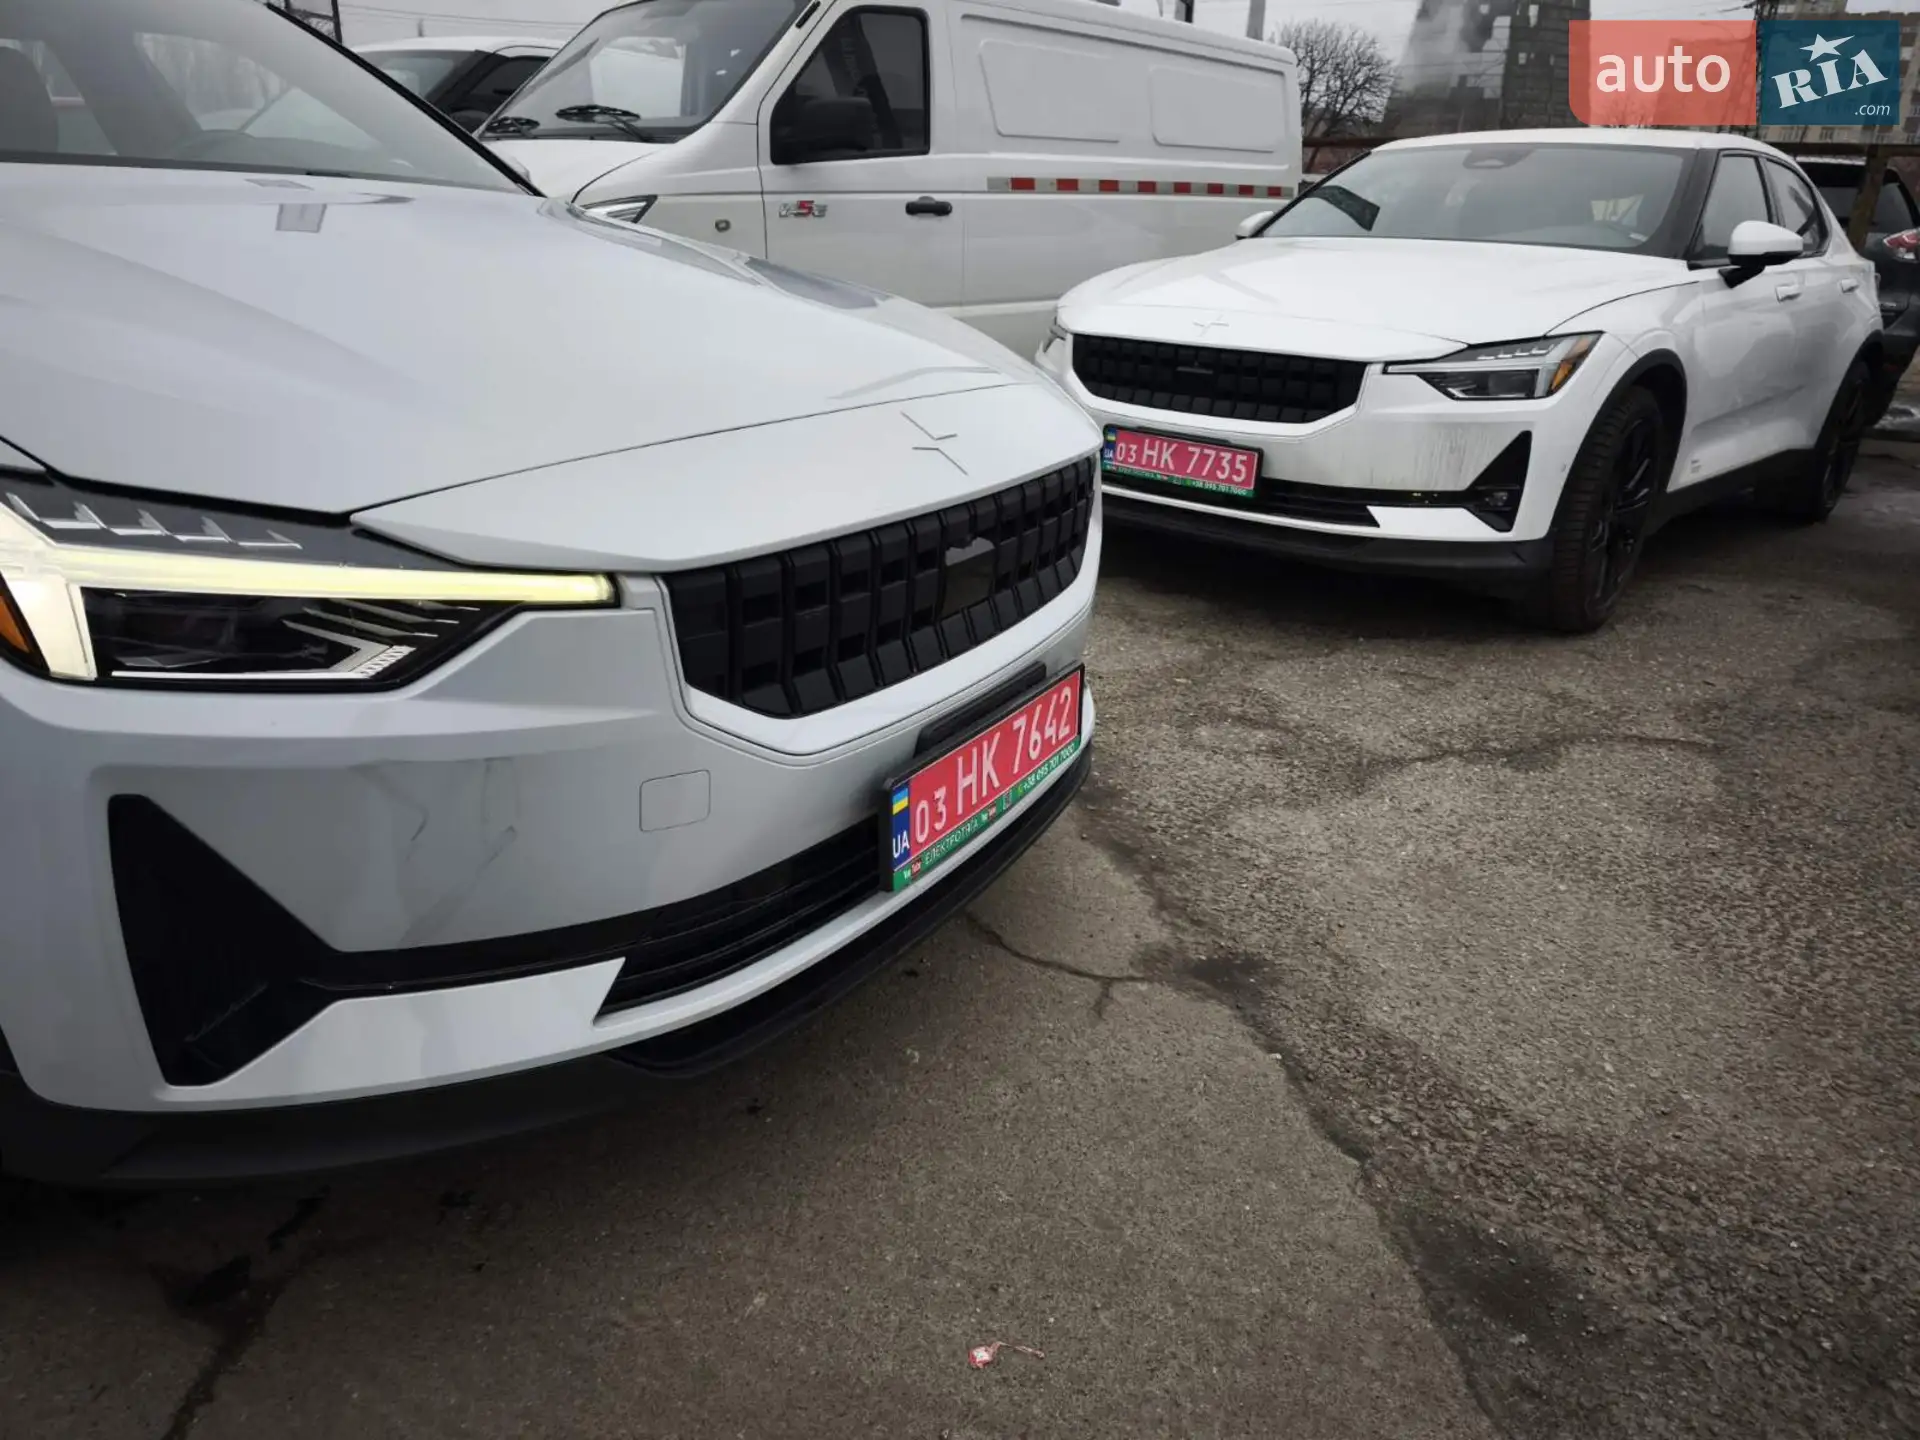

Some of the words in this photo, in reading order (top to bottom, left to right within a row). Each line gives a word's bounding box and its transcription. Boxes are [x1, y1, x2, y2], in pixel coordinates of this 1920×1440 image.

[1116, 442, 1137, 463] 03
[1142, 439, 1179, 470] HK
[1186, 446, 1247, 483] 7735
[915, 786, 947, 843] 03
[957, 731, 1001, 815] HK
[1013, 686, 1071, 774] 7642
[893, 830, 910, 858] UA
